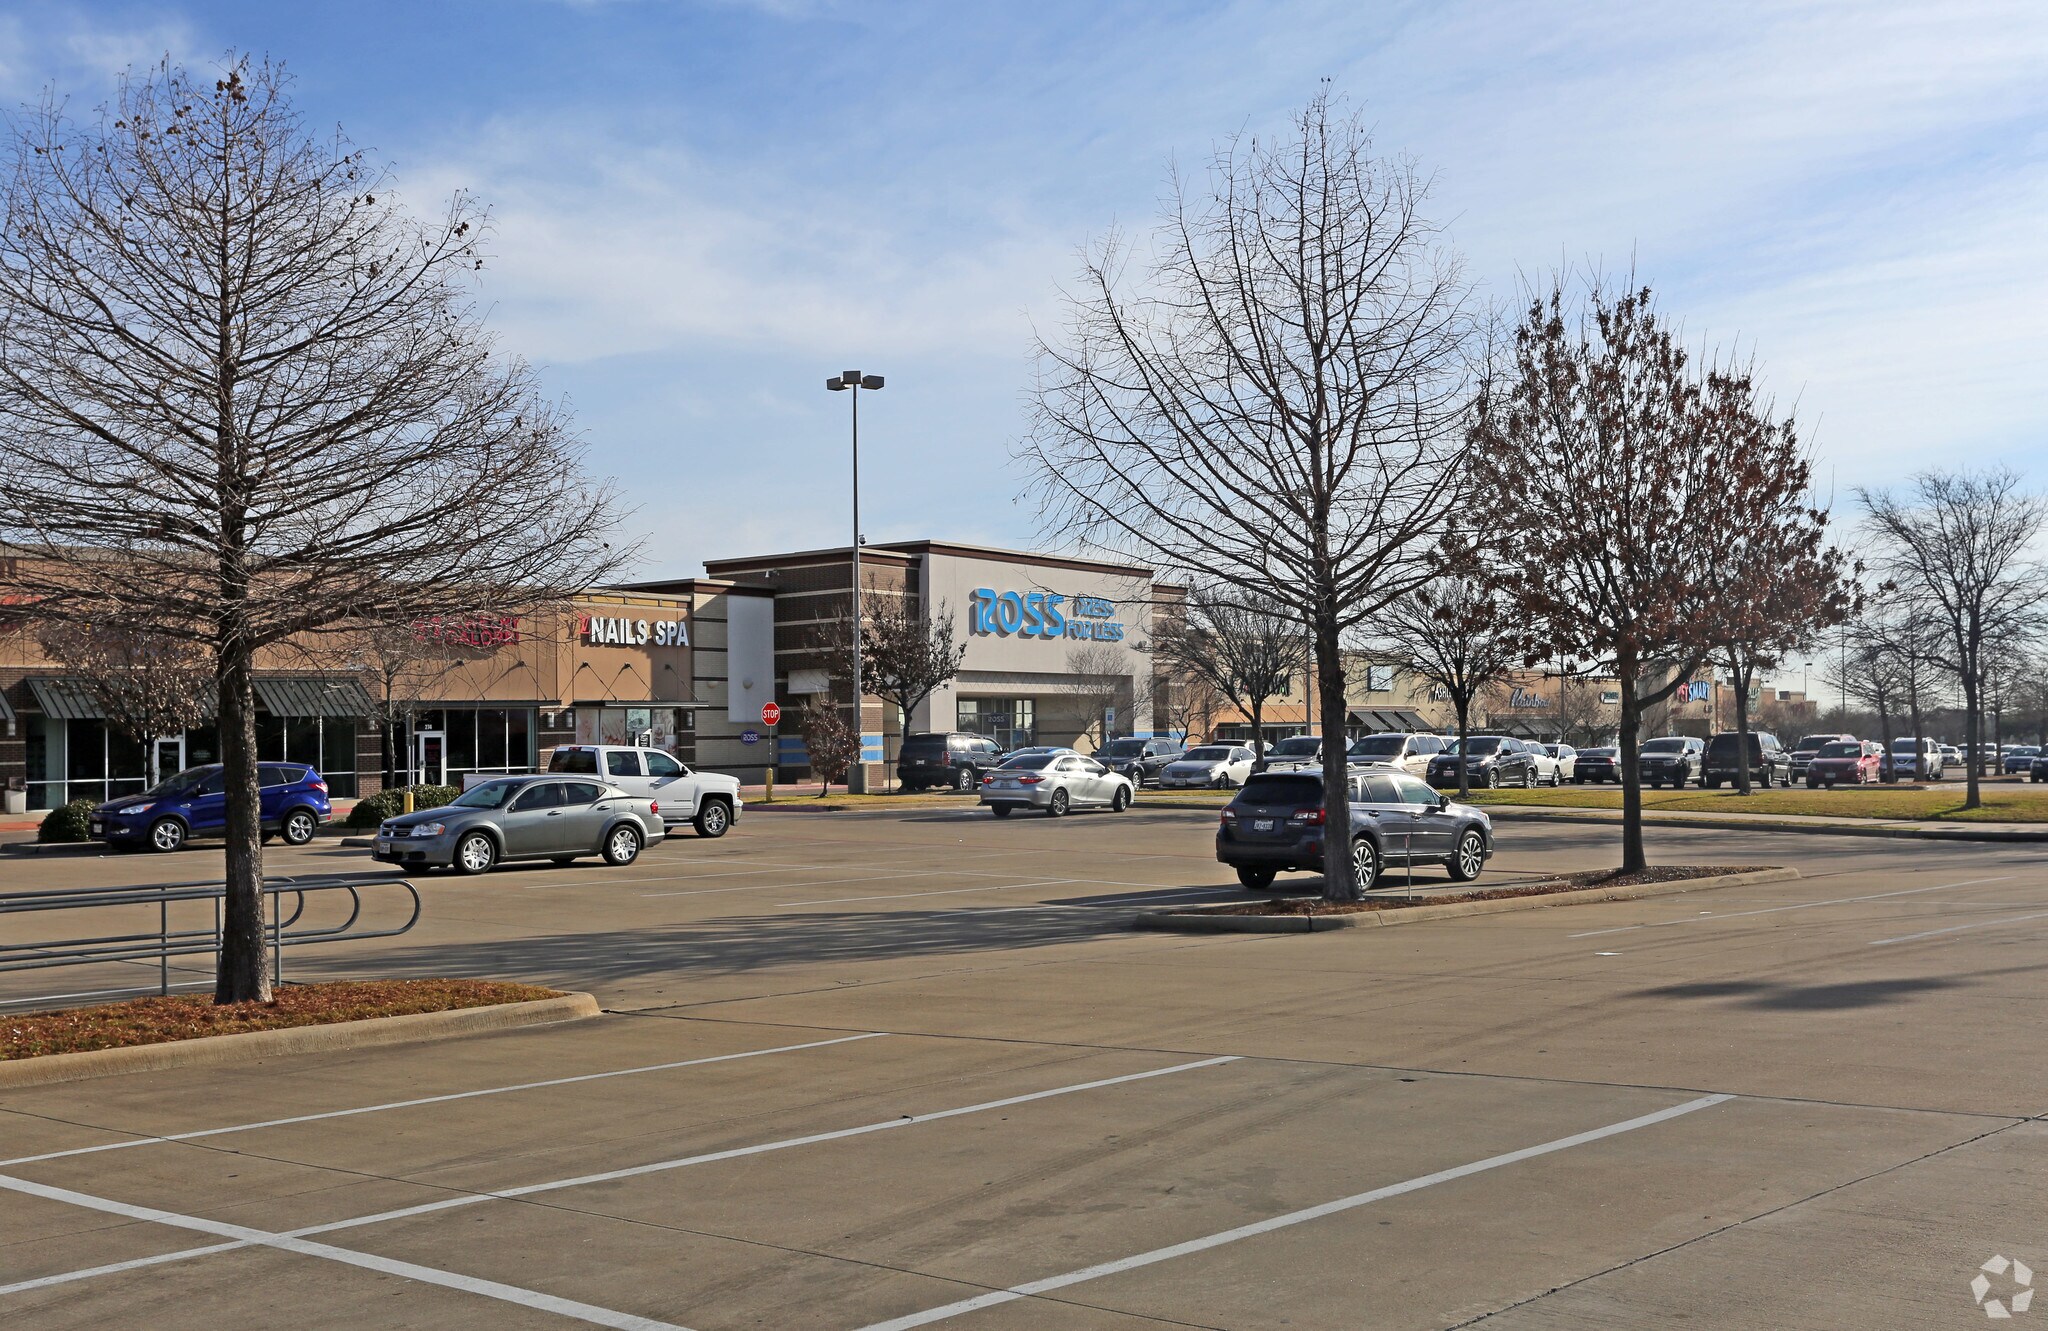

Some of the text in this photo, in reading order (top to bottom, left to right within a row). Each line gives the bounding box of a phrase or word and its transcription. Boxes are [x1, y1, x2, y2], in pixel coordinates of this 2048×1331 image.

[975, 588, 1065, 636] ROSS
[1076, 597, 1115, 617] DRESS
[591, 617, 648, 645] NAILS
[655, 620, 689, 646] SPA
[1067, 619, 1125, 640] FOR LESS
[763, 709, 778, 718] STOP
[743, 733, 758, 742] ROSS
